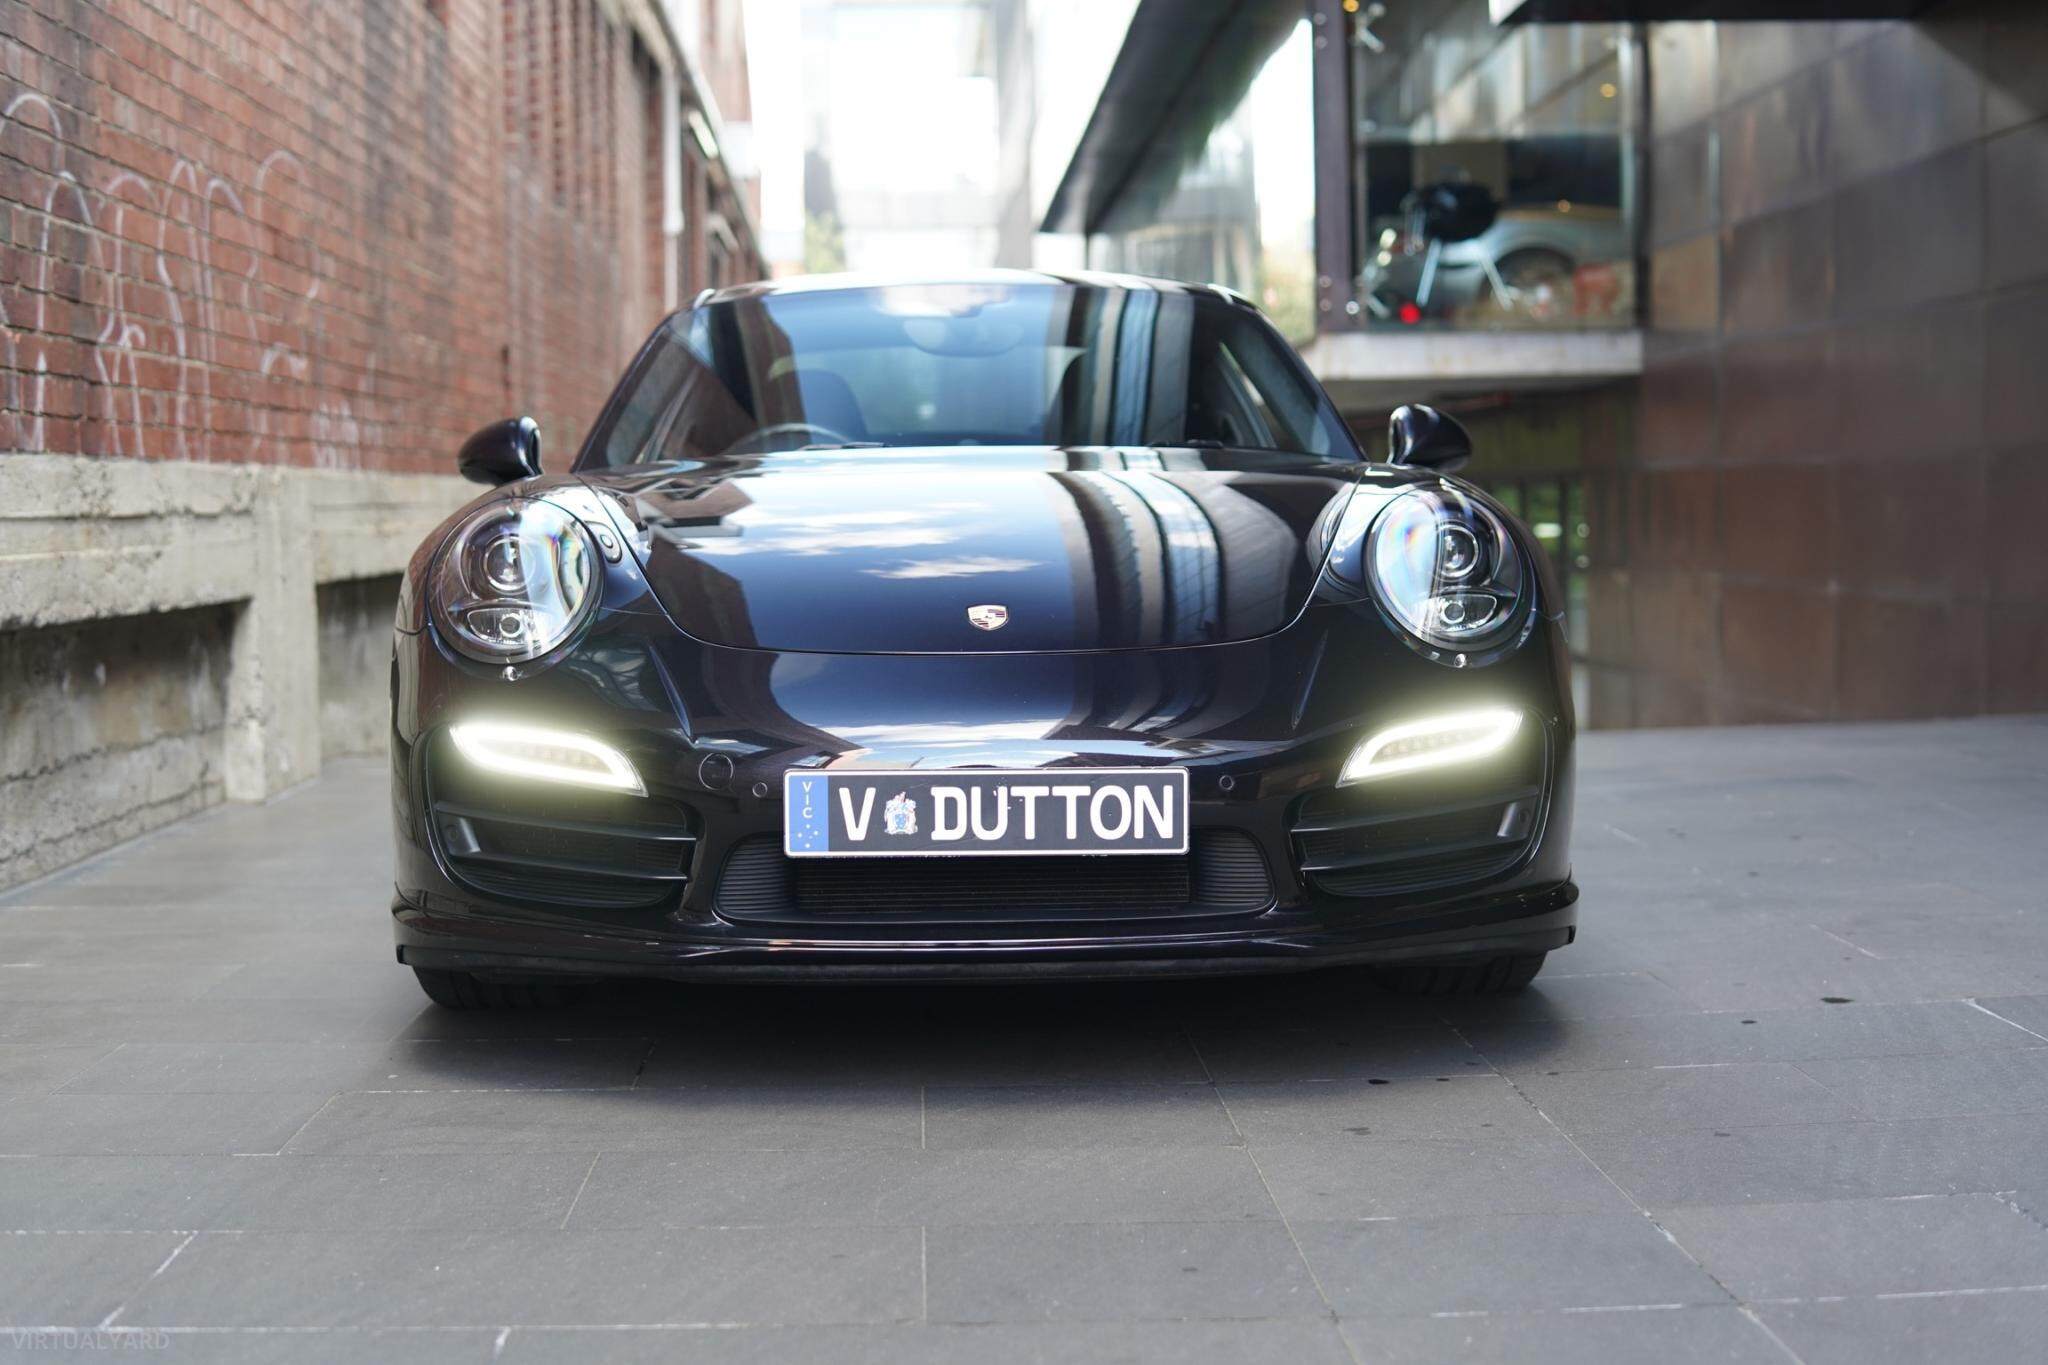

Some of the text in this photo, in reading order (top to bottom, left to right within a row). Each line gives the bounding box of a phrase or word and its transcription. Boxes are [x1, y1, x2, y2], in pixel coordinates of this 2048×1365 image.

[801, 780, 814, 819] VIC
[838, 785, 1174, 841] V DUTTON
